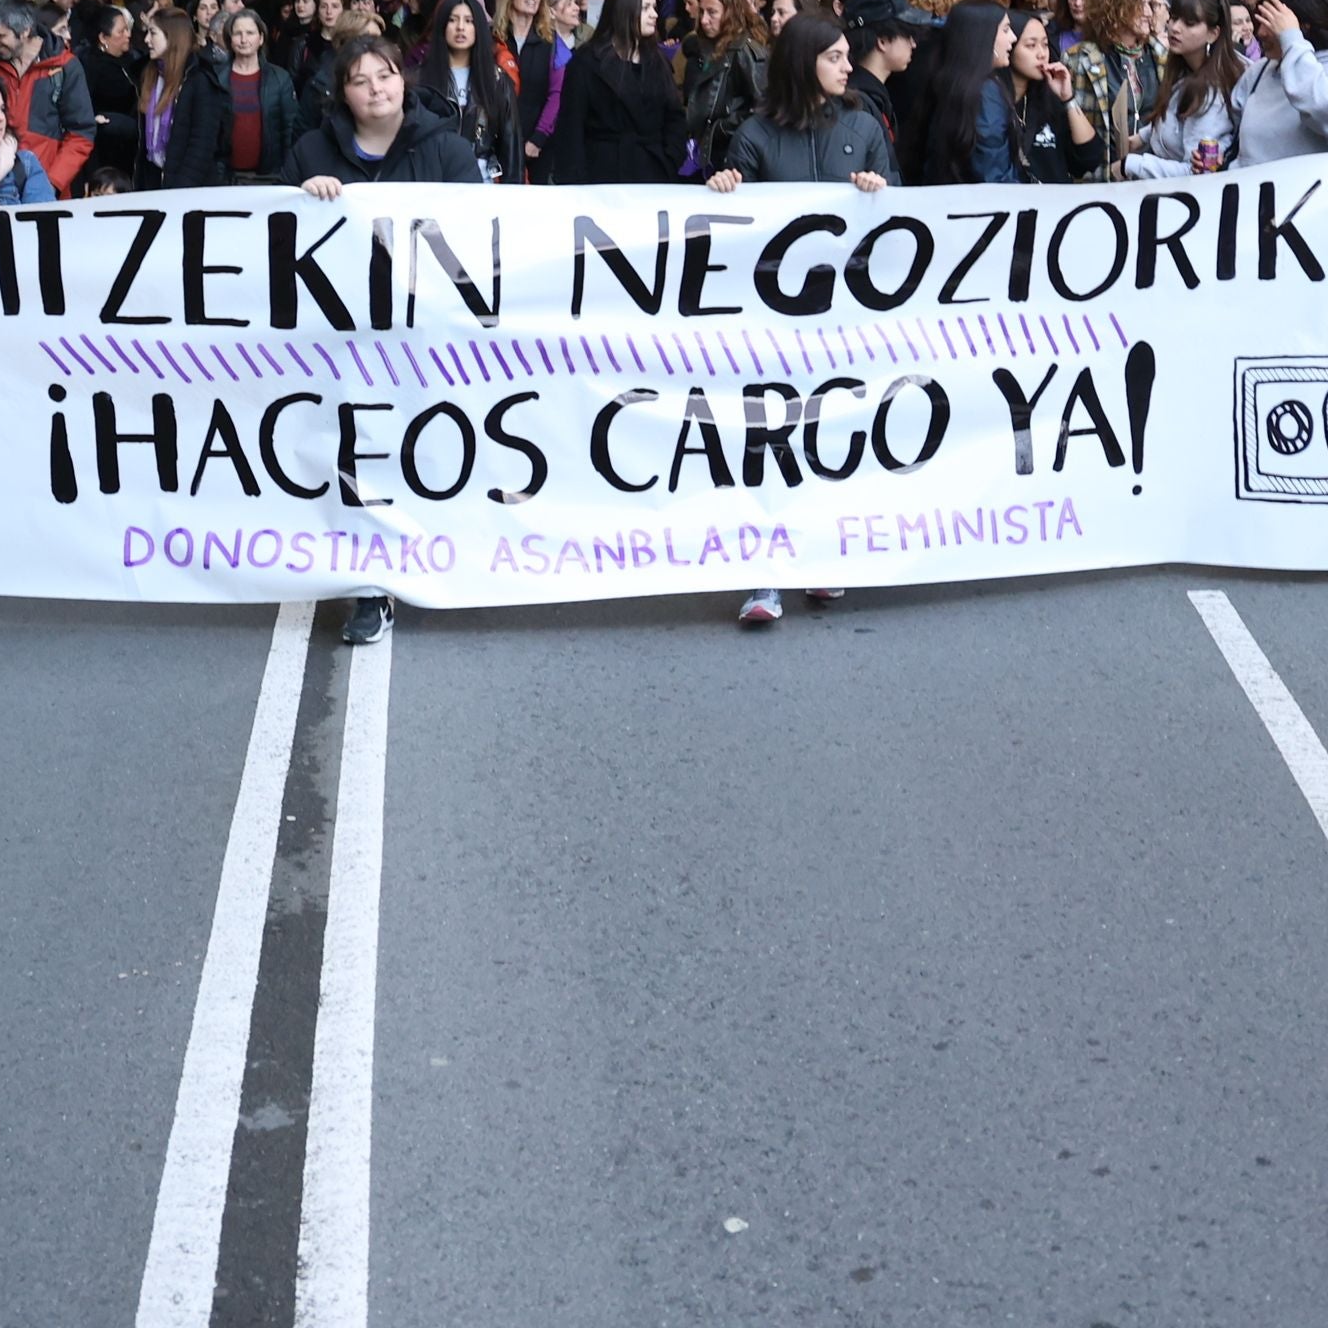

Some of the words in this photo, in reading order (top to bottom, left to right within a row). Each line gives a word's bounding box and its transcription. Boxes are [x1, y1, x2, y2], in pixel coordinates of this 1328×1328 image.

[571, 179, 1326, 320] NEGOZIORIK
[47, 383, 549, 508] ¡HACEOS
[590, 374, 951, 493] CARGO
[991, 340, 1156, 497] YA!
[123, 526, 457, 574] DONOSTIAKO
[489, 520, 797, 575] ASANBLADA
[837, 497, 1083, 556] FEMINISTA
